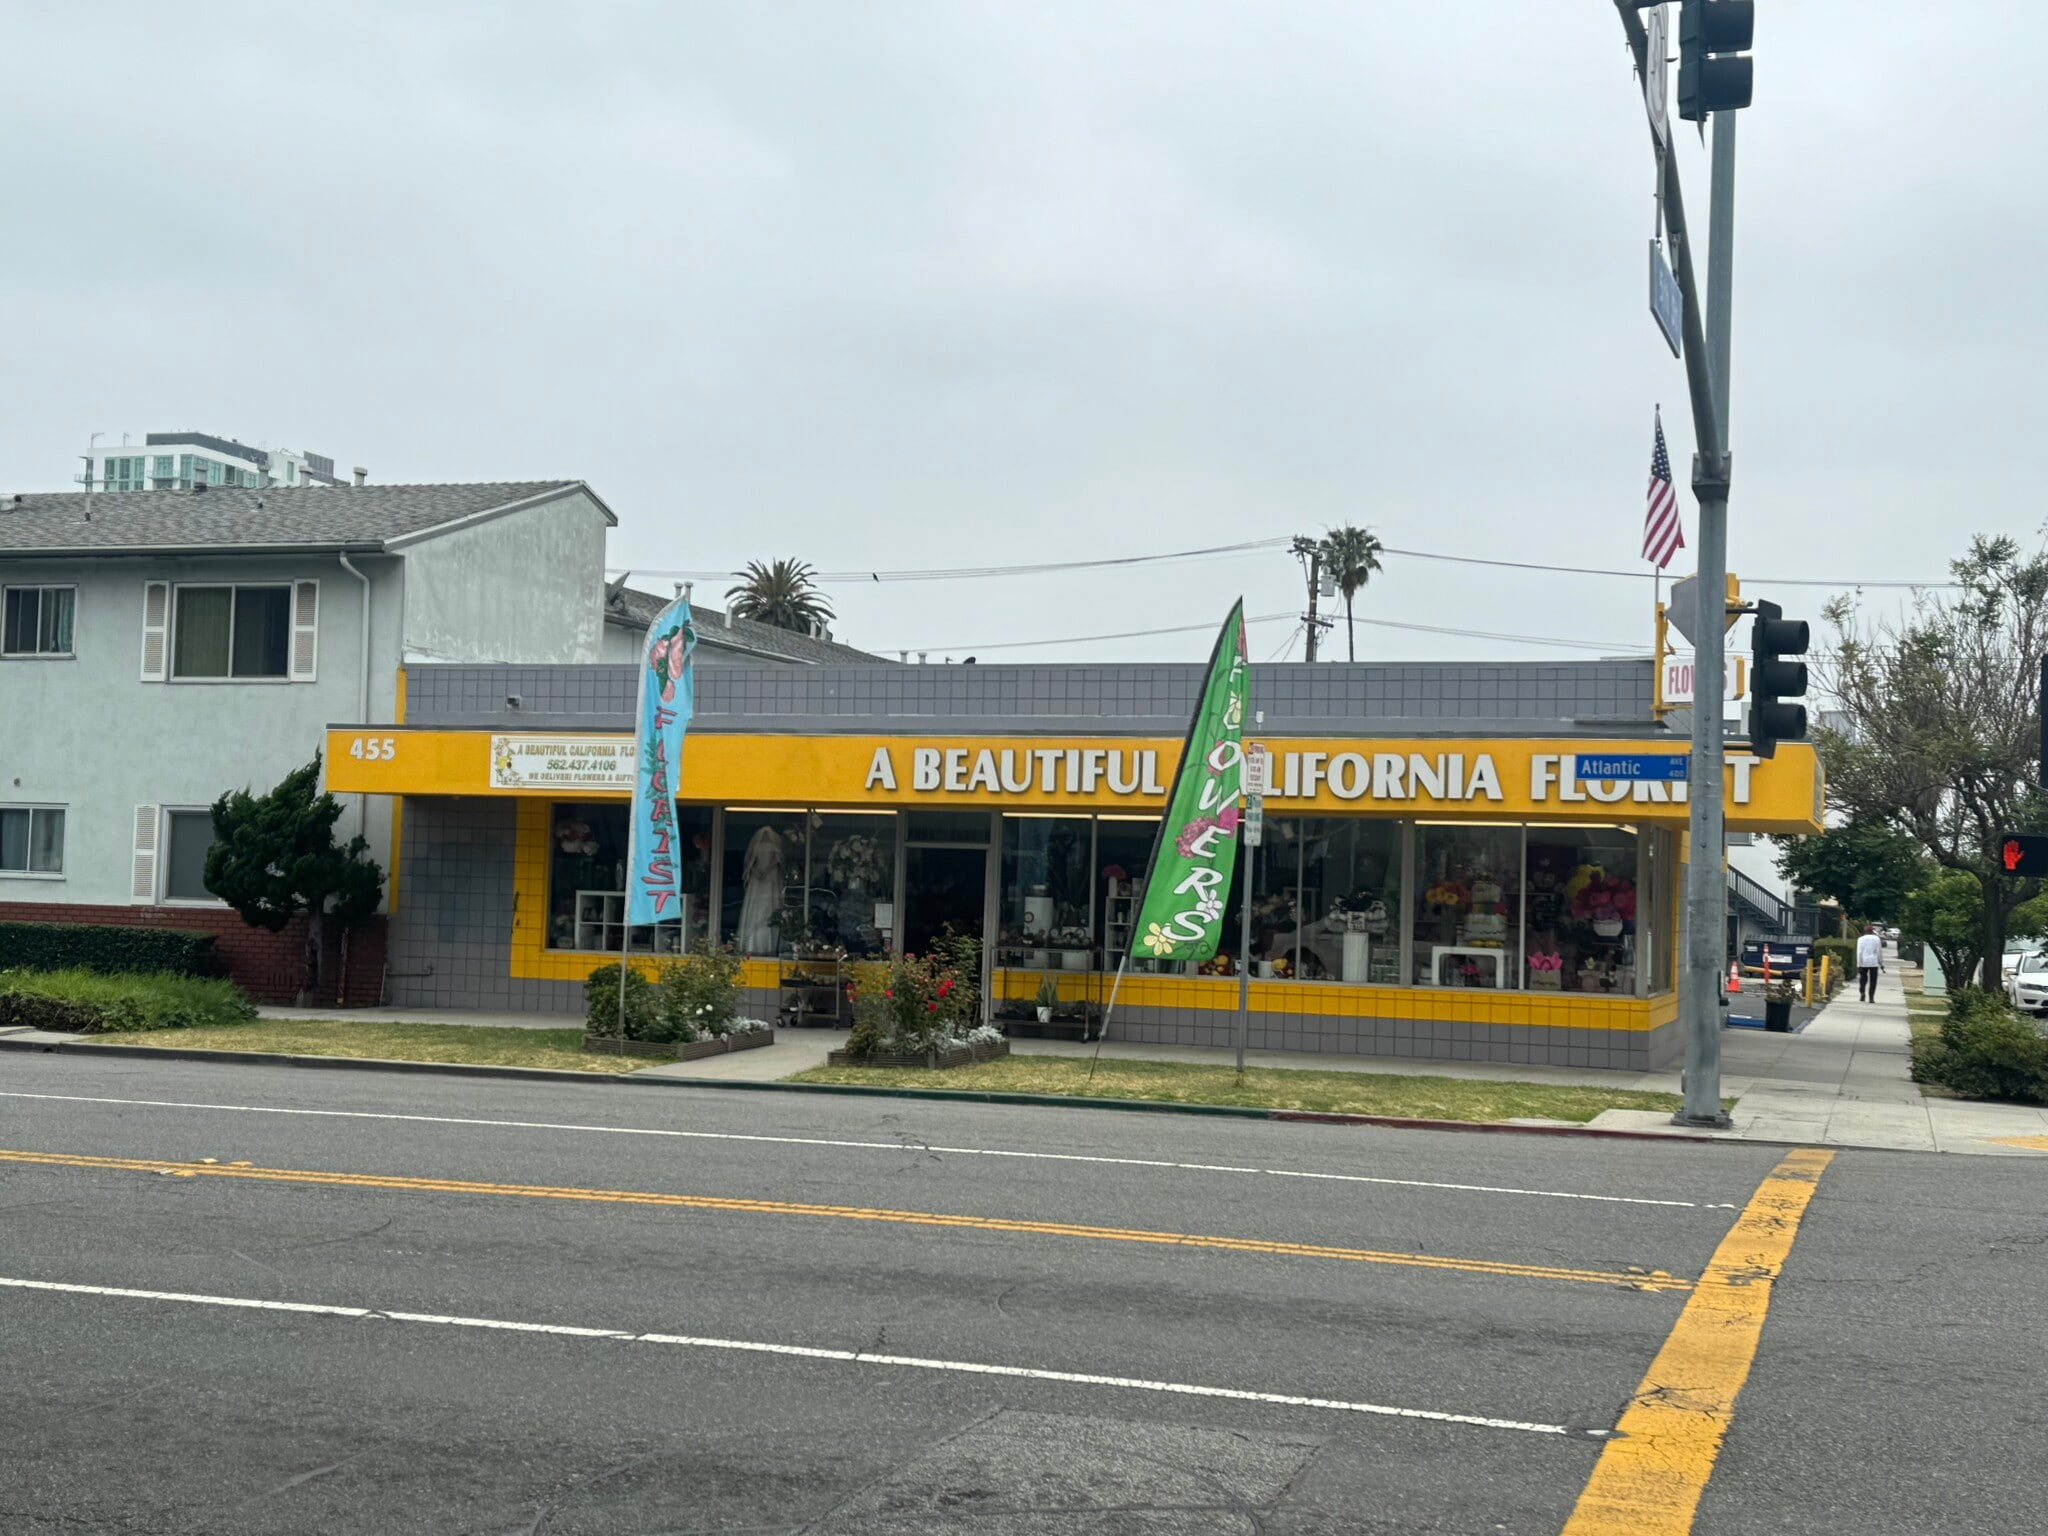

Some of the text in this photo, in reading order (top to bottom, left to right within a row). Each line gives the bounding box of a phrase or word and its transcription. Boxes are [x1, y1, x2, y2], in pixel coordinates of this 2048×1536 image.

[1668, 663, 1728, 694] FLOS
[350, 737, 396, 760] 455
[525, 744, 567, 756] BEAUTIFUL
[570, 745, 616, 757] CALIFORNIA
[547, 759, 617, 771] 562.437.4106
[1581, 759, 1641, 775] Atlantic
[1669, 757, 1685, 766] AVE
[528, 772, 538, 780] WE
[574, 773, 606, 781] FLOWERS
[865, 746, 897, 790] A
[913, 747, 1165, 794] BEAUTIFUL
[1240, 751, 1504, 800] LIFORNIA
[1668, 770, 1685, 778] 400
[1161, 654, 1247, 942] FLOWERS
